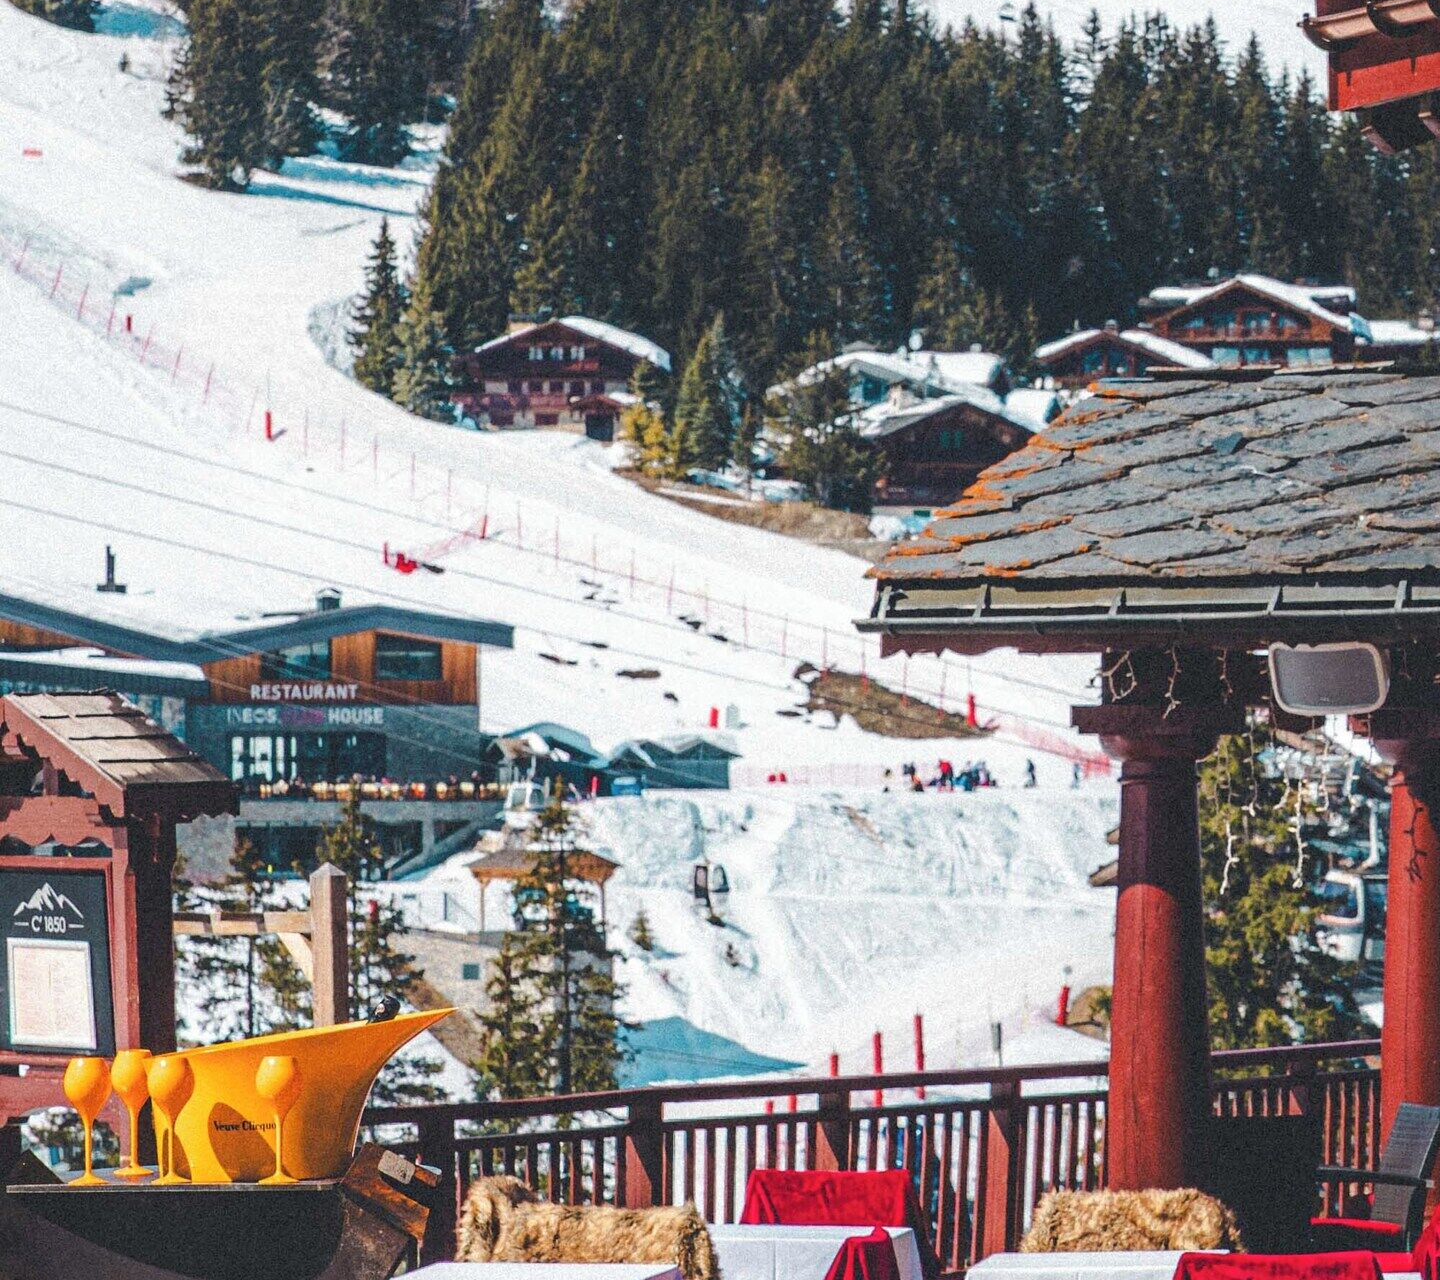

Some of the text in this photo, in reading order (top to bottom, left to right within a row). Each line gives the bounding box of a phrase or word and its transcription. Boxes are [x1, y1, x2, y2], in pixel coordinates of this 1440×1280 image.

[250, 684, 358, 700] RESTAURANT
[328, 707, 384, 724] HOUSE
[213, 1120, 277, 1132] Veuve Clicquo
